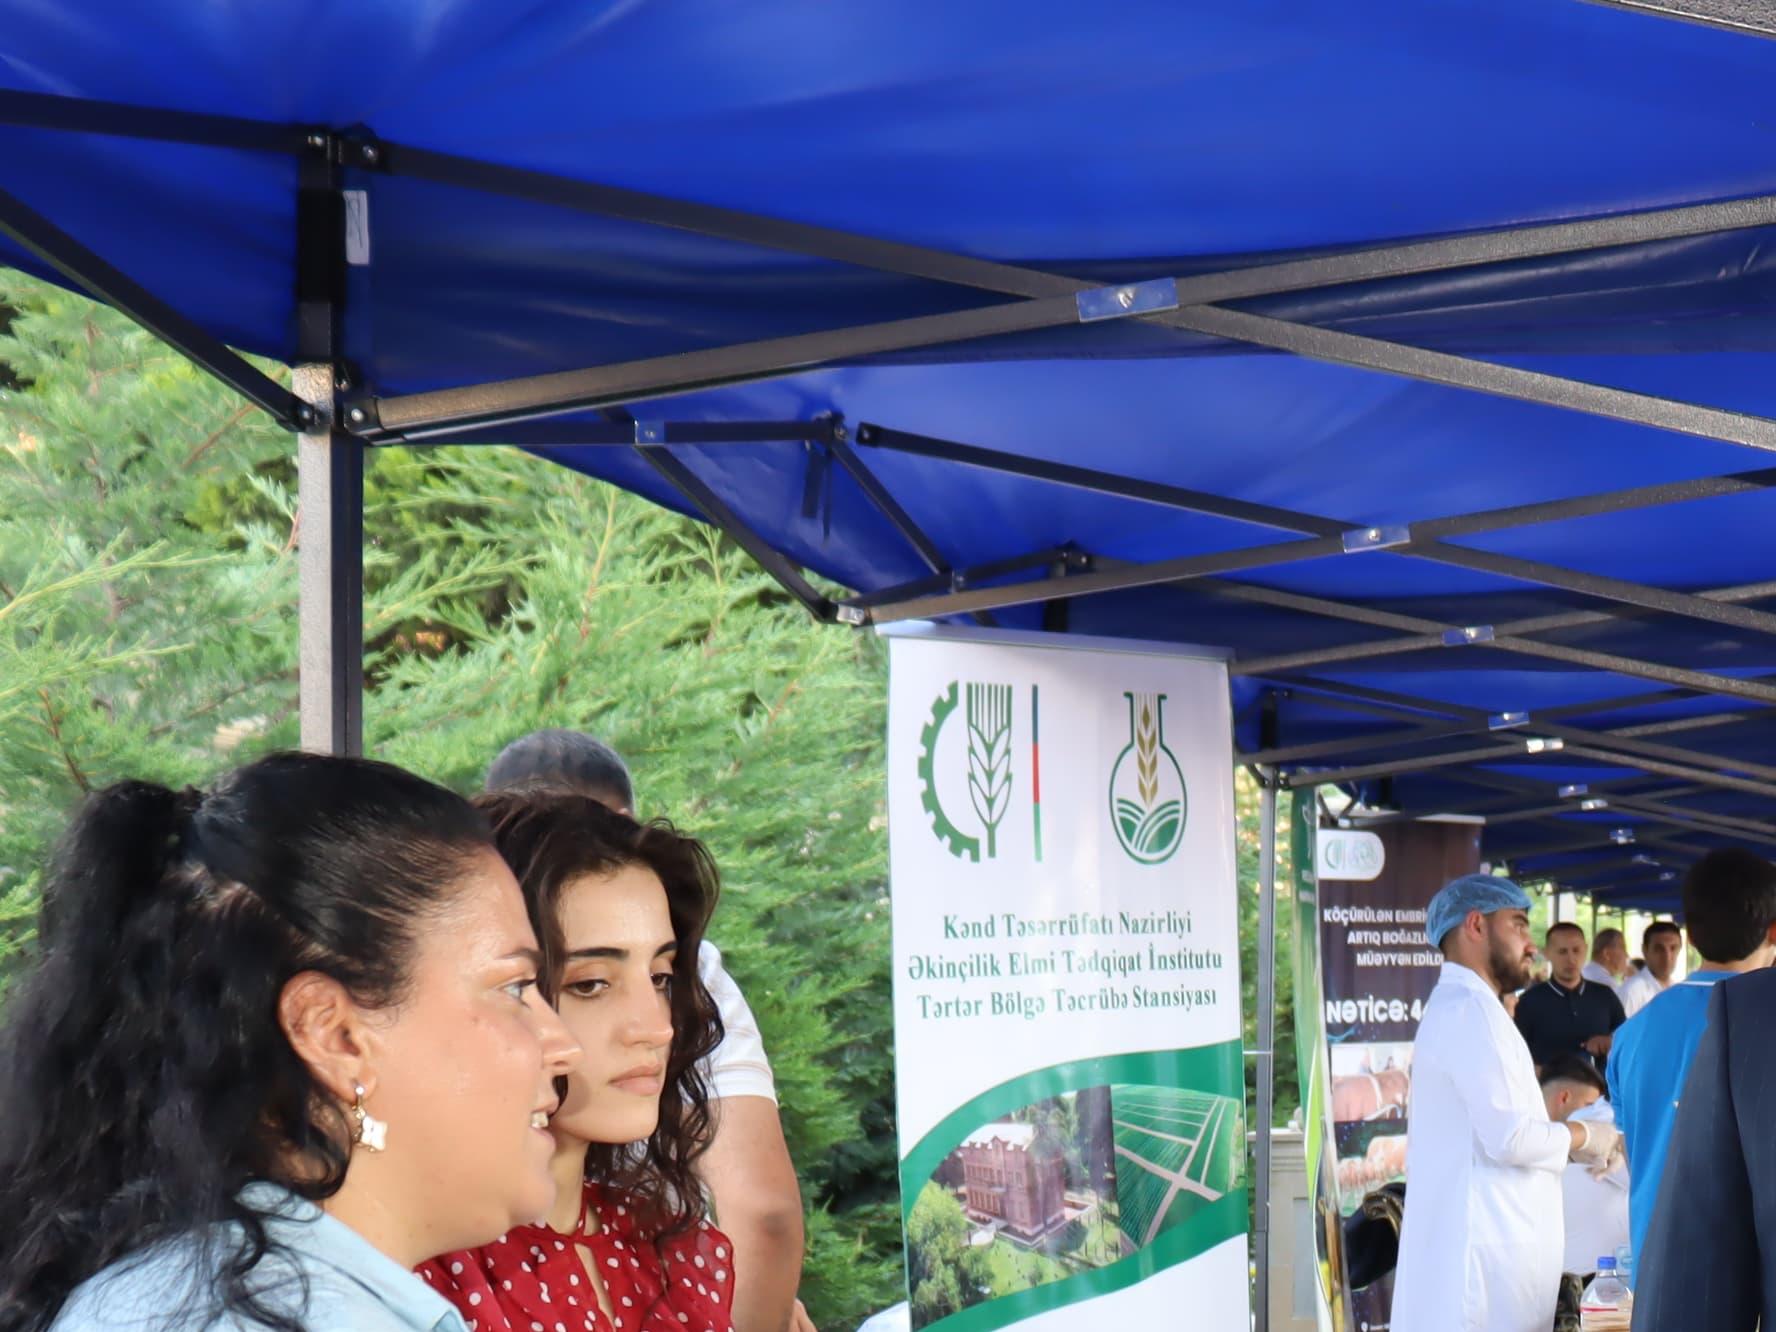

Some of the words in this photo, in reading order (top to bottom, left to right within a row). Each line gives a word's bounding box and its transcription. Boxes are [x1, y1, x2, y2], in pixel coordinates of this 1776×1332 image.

[943, 913, 996, 939] Kənd
[1119, 910, 1192, 939] Nazirliyi
[908, 953, 1001, 983] Əkinçilik
[1008, 951, 1056, 976] Elmi
[1061, 948, 1142, 978] Tədqiqat
[1149, 942, 1222, 971] İnstitutu
[917, 994, 983, 1019] Tərtər
[991, 991, 1046, 1020] Bölgə
[1054, 986, 1128, 1012] Təcrübə
[1132, 983, 1217, 1012] Stansiyası
